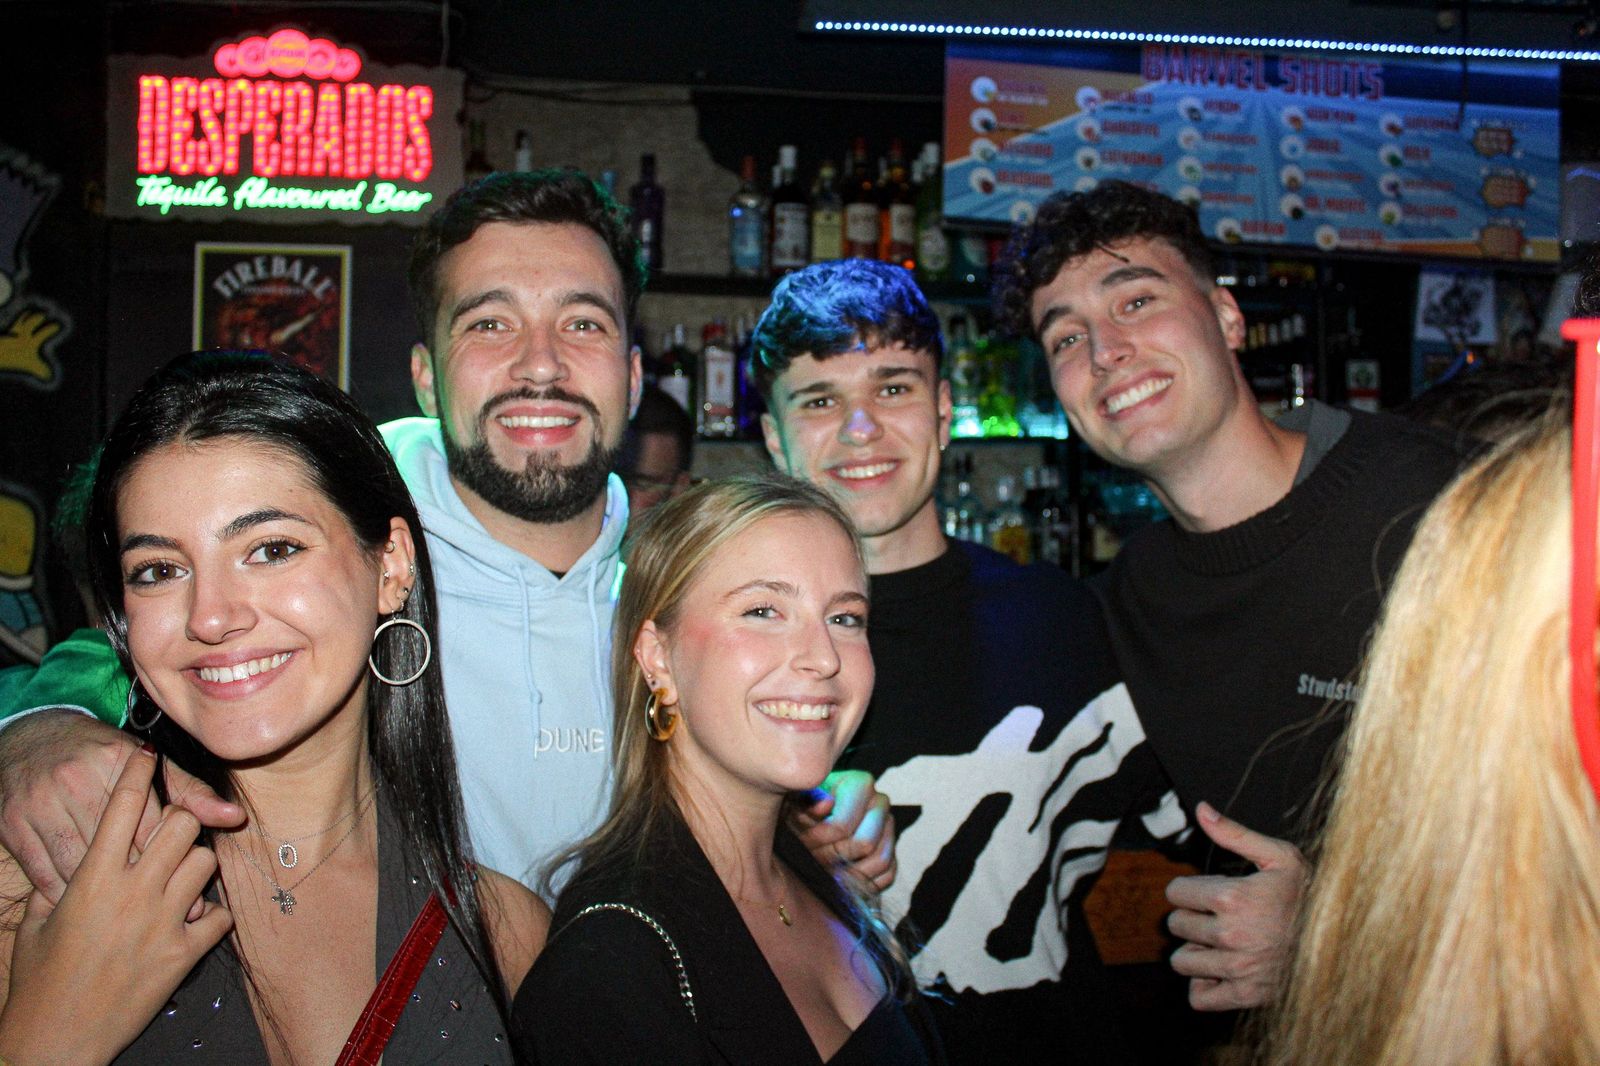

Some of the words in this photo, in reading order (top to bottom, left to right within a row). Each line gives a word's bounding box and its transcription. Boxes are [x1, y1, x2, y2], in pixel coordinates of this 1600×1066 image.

[1280, 55, 1383, 100] SHOTS
[137, 75, 433, 182] DESPERADOS
[136, 175, 228, 214] Tequila
[233, 177, 367, 210] Flavoured
[366, 182, 432, 213] Beer
[213, 256, 333, 300] FIREBALL
[535, 727, 604, 753] DUNE
